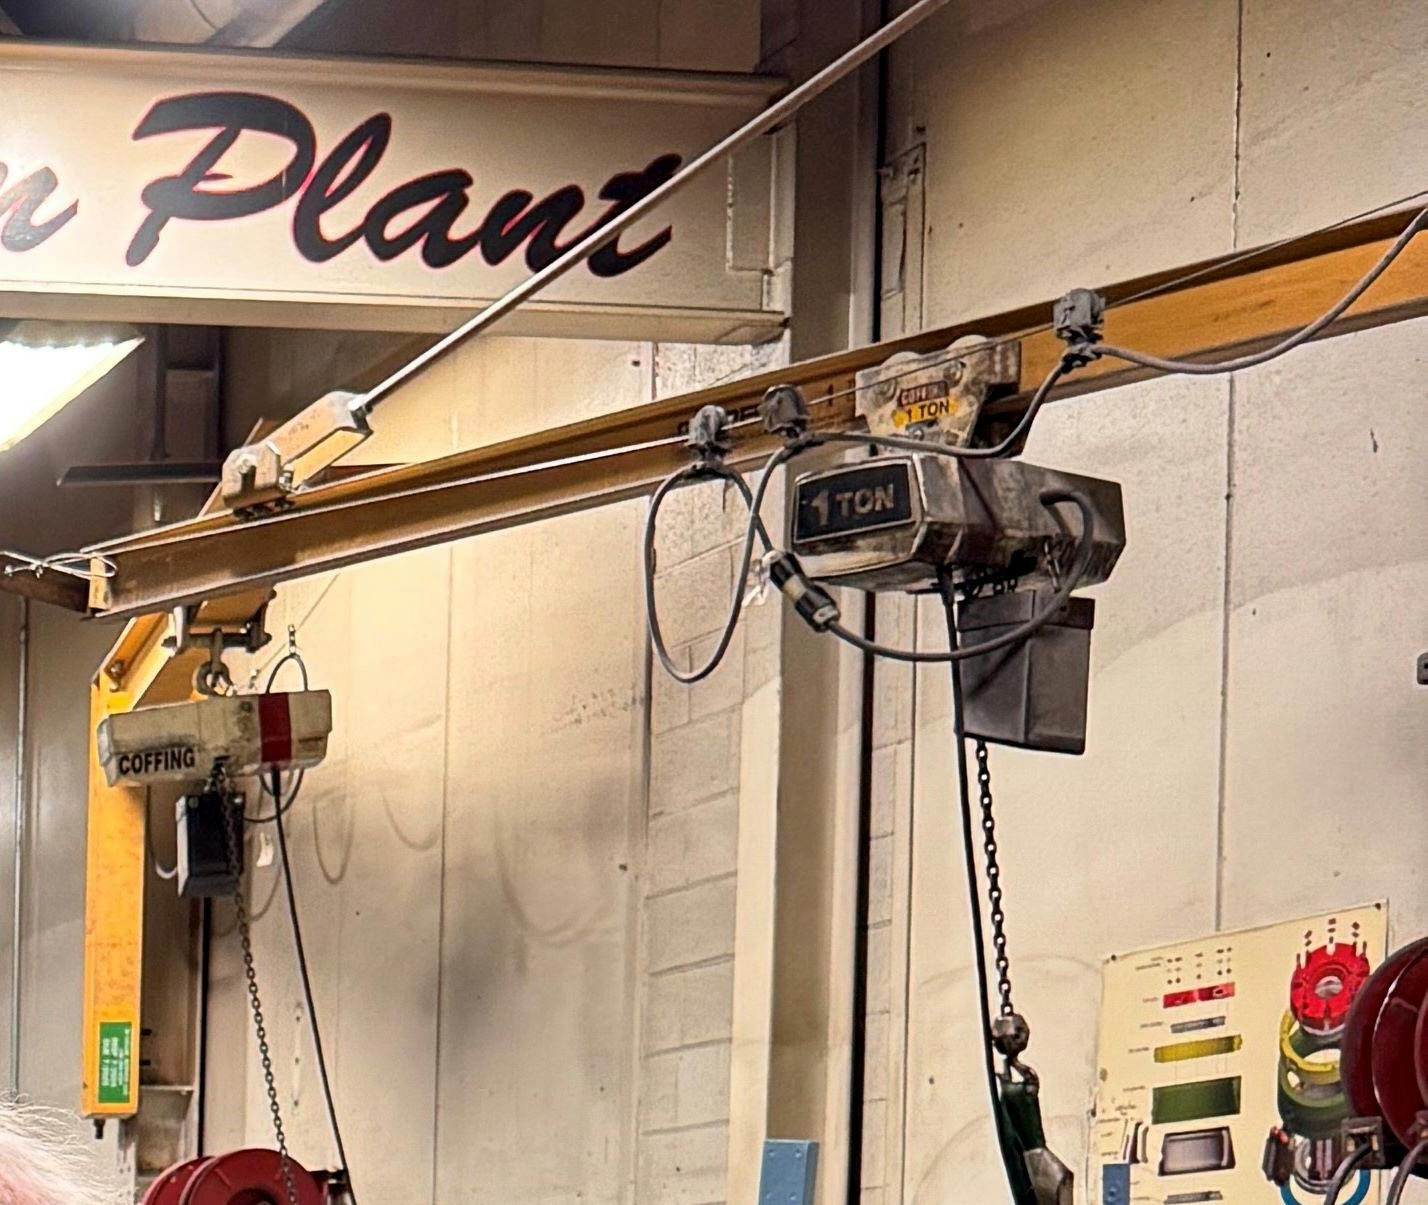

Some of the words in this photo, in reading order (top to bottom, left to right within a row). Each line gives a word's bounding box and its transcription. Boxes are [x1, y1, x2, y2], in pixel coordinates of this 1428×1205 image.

[123, 90, 684, 278] Plant
[919, 399, 950, 419] TON
[811, 488, 829, 526] 1
[836, 483, 894, 518] TON
[119, 747, 196, 776] COFFING
